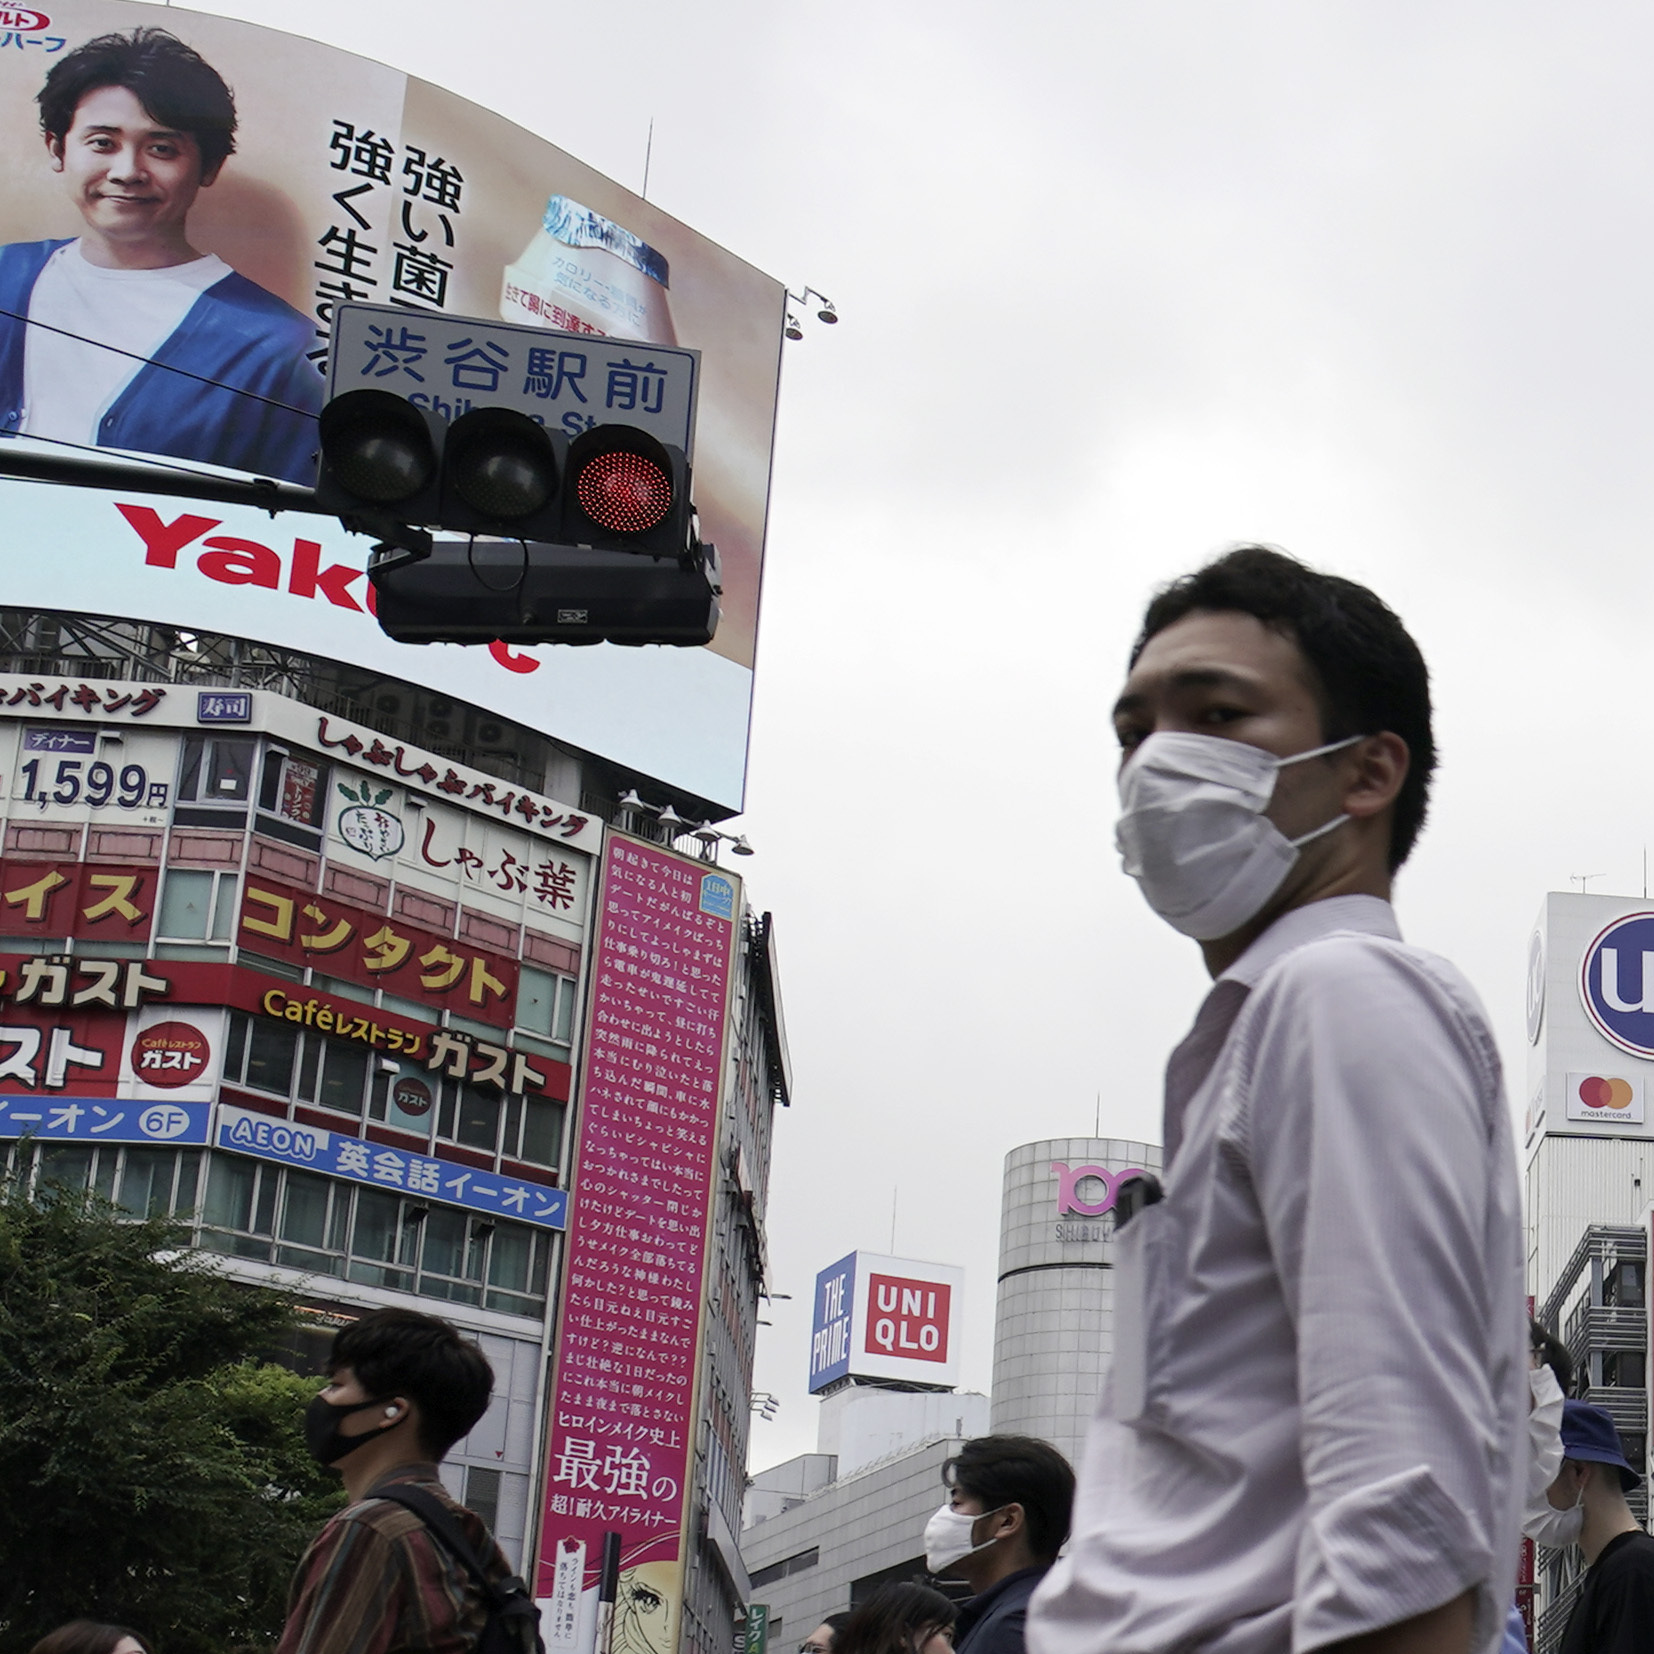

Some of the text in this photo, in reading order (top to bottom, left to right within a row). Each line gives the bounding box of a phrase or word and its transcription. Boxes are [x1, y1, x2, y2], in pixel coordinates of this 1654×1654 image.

[389, 145, 464, 309] 強い菌
[361, 322, 669, 415] 渋谷駅前
[201, 696, 247, 719] 寿司
[30, 731, 91, 749] ディナー
[21, 758, 169, 811] 1,599円
[317, 715, 590, 838] しゃぶしゃぶバイキング
[421, 816, 577, 910] しゃぶ葉
[241, 886, 507, 1006] コンタクト
[16, 956, 168, 1008] ガスト
[140, 1050, 202, 1070] ガスト
[427, 1031, 546, 1095] ガスト
[145, 1111, 184, 1134] 6F
[1580, 1109, 1632, 1120] mastercard
[231, 1118, 562, 1218] AEON 英会話イーオン
[825, 1272, 846, 1324] THE
[878, 1283, 936, 1319] UNI
[811, 1315, 849, 1376] PRIME
[874, 1317, 939, 1352] QLO
[558, 1410, 681, 1449] ヒロインメイク史上
[552, 1435, 678, 1502] 最強の
